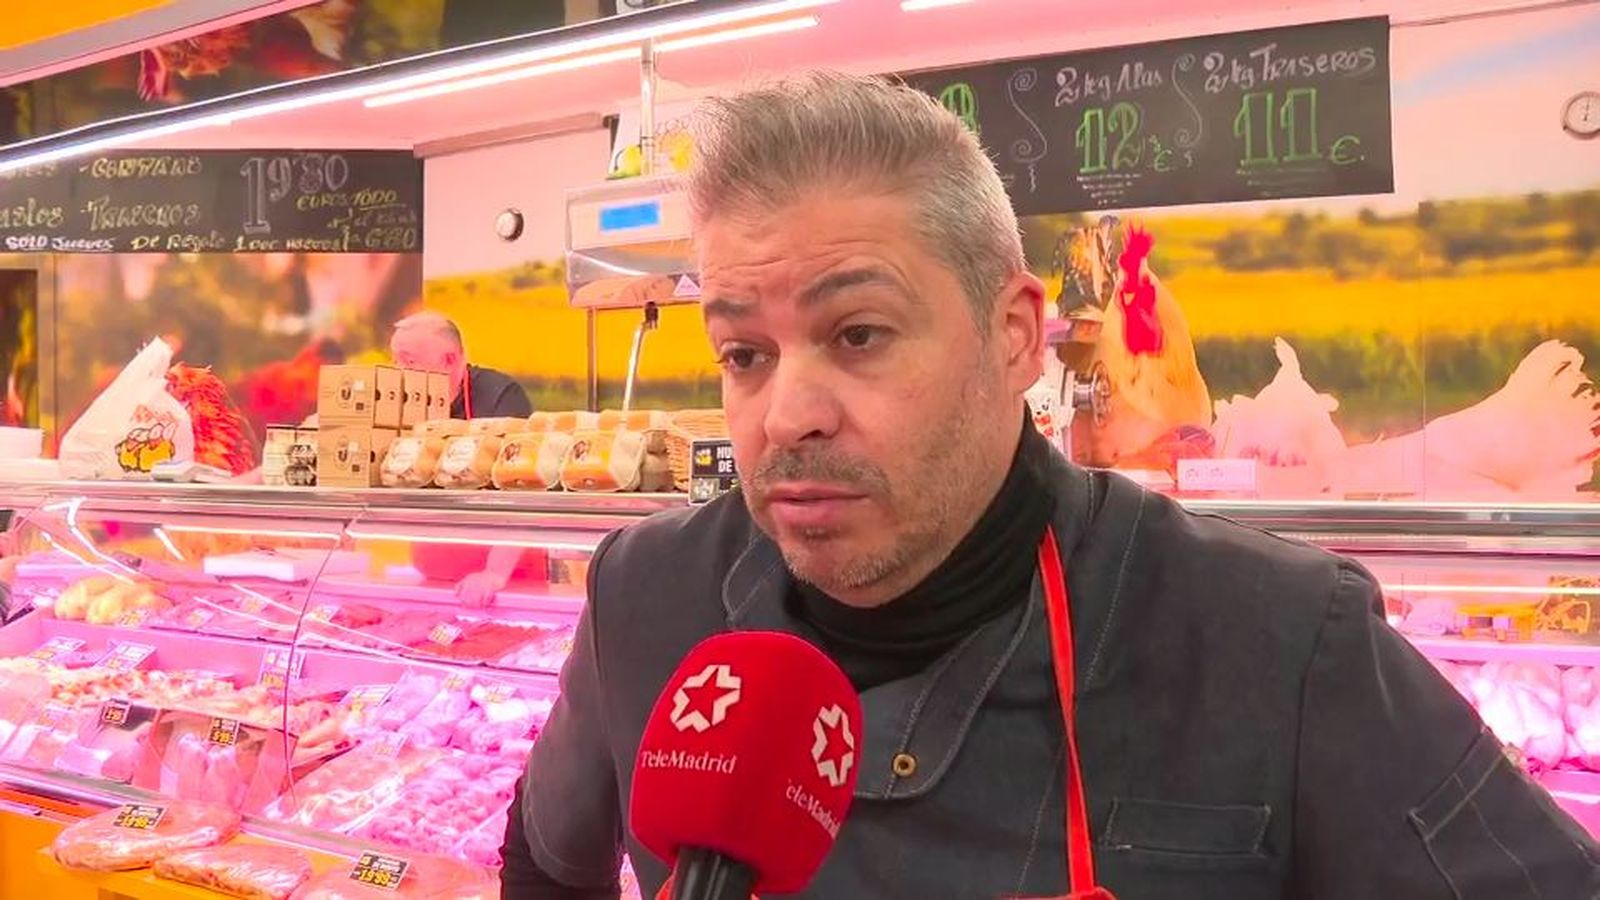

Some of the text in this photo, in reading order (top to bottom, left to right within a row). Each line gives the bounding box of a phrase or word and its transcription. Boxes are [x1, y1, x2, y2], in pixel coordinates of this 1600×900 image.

[1116, 61, 1162, 94] Alas
[1075, 101, 1140, 173] 12
[1233, 88, 1322, 166] 11
[718, 460, 733, 473] DE
[641, 749, 737, 774] TeleMadrid
